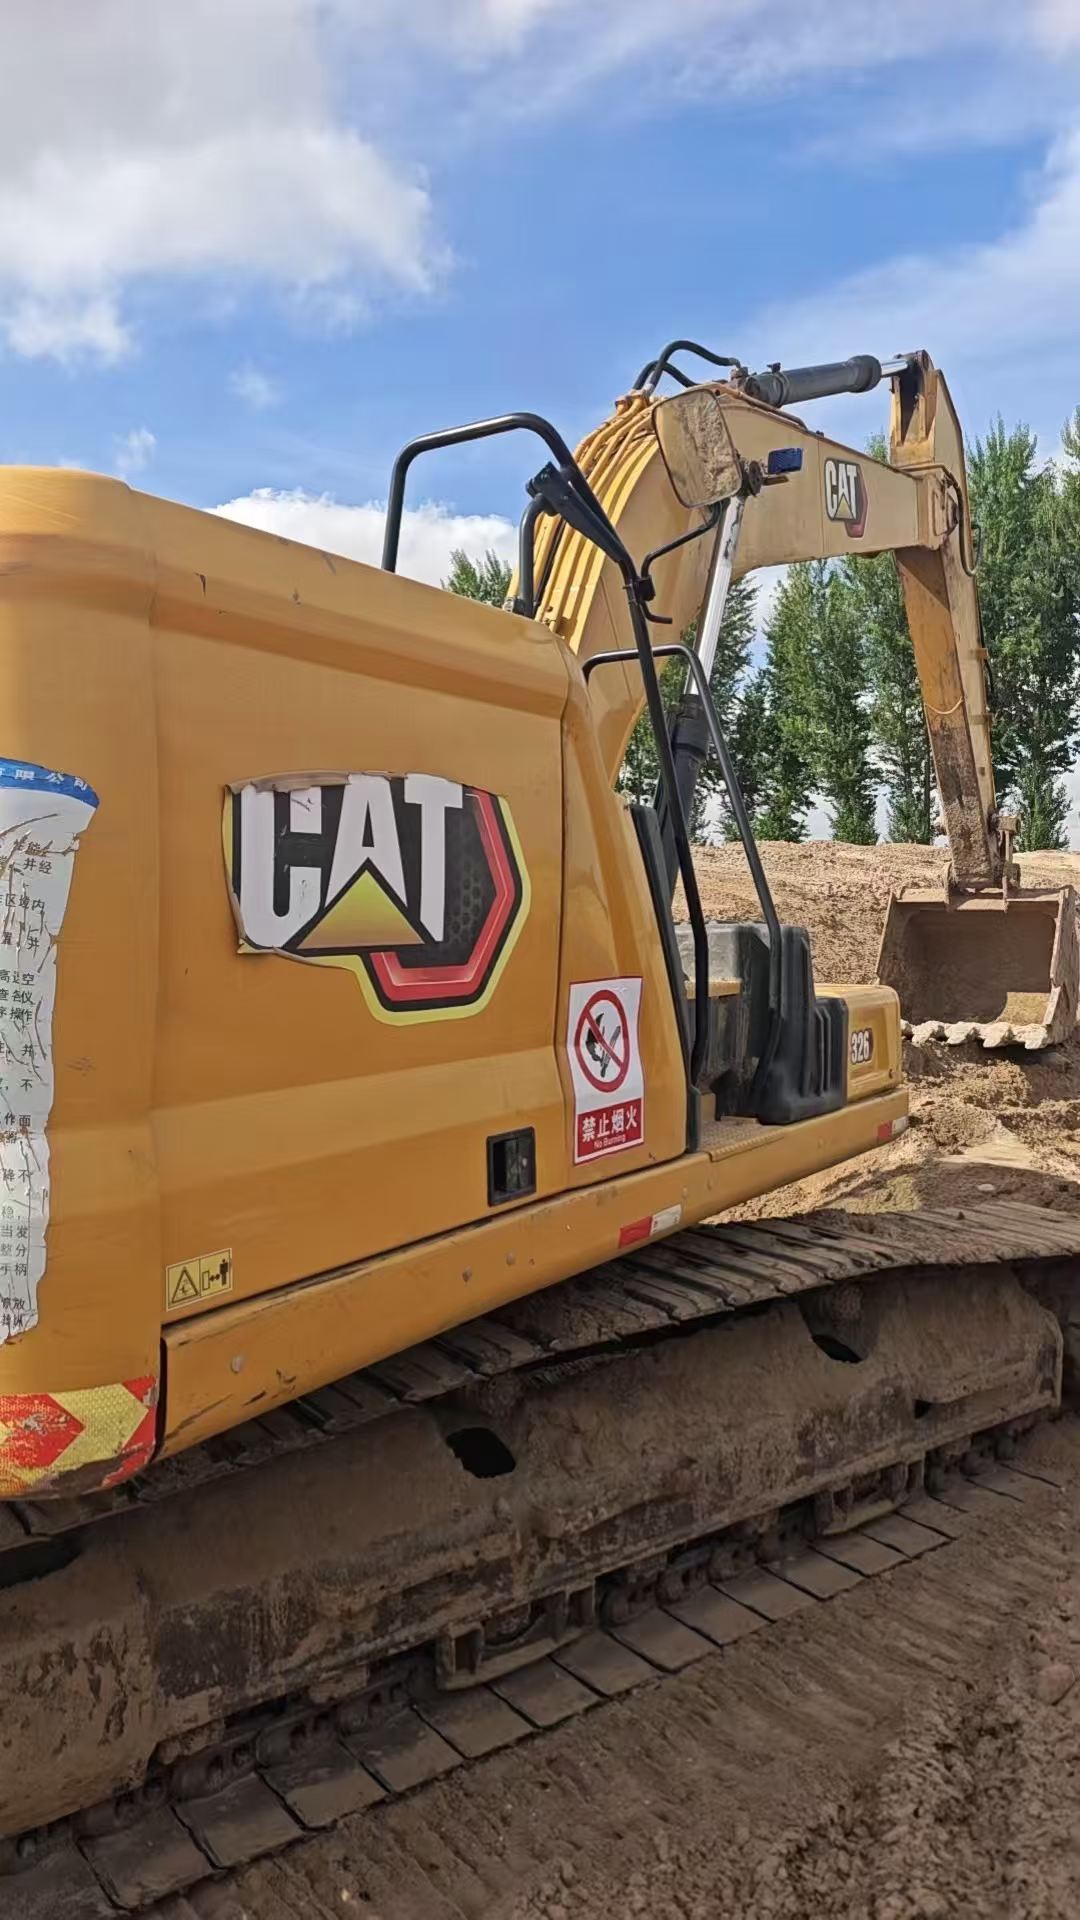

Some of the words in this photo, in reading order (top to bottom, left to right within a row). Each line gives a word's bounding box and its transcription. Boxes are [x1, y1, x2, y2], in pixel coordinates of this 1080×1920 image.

[825, 460, 857, 520] CAT
[240, 773, 463, 949] CAT
[851, 1029, 871, 1064] 326
[582, 1105, 637, 1143] 禁止烟火
[593, 1140, 603, 1149] No
[603, 1134, 626, 1147] Burning
